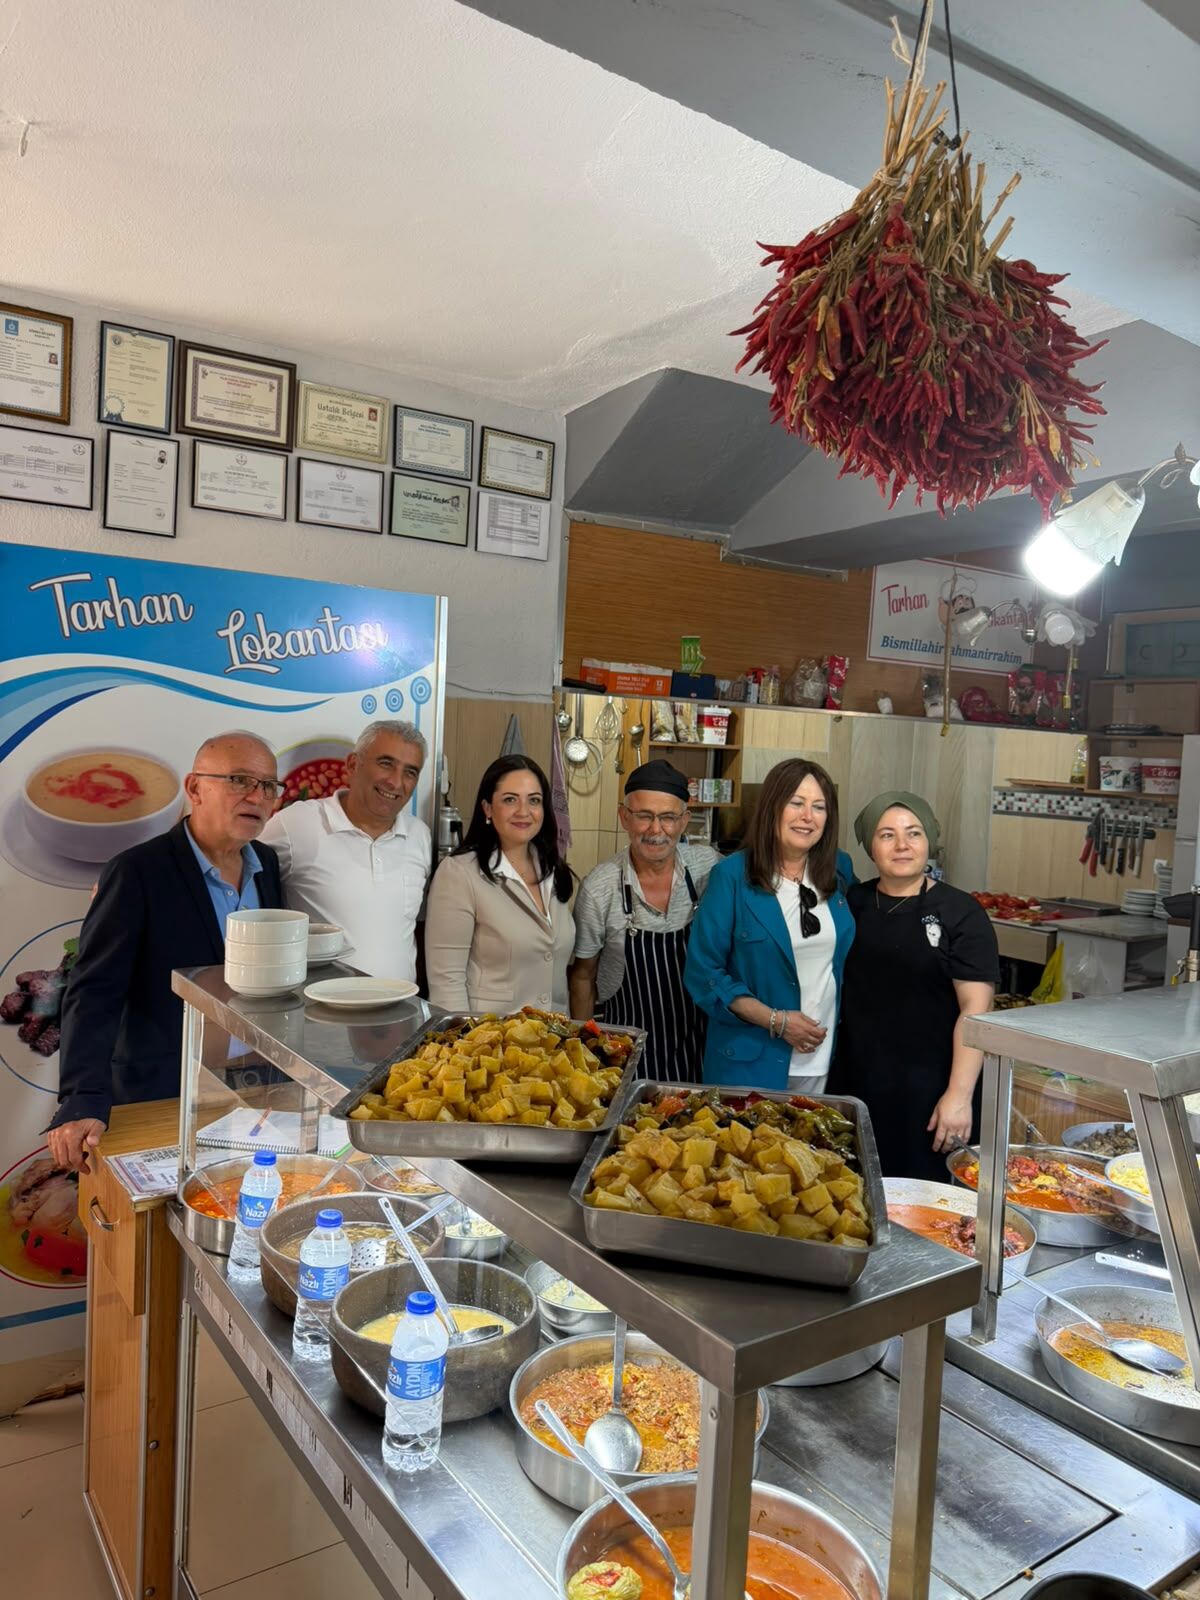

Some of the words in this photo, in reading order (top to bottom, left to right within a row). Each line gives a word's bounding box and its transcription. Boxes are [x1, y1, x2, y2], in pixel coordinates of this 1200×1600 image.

[880, 584, 929, 616] Tarhan
[28, 572, 195, 638] Tarhan
[216, 607, 390, 675] Lokantası
[880, 635, 1022, 665] Bismillahirahmanirrahim
[321, 1268, 337, 1297] AYDIN
[405, 1363, 421, 1397] AYDIN
